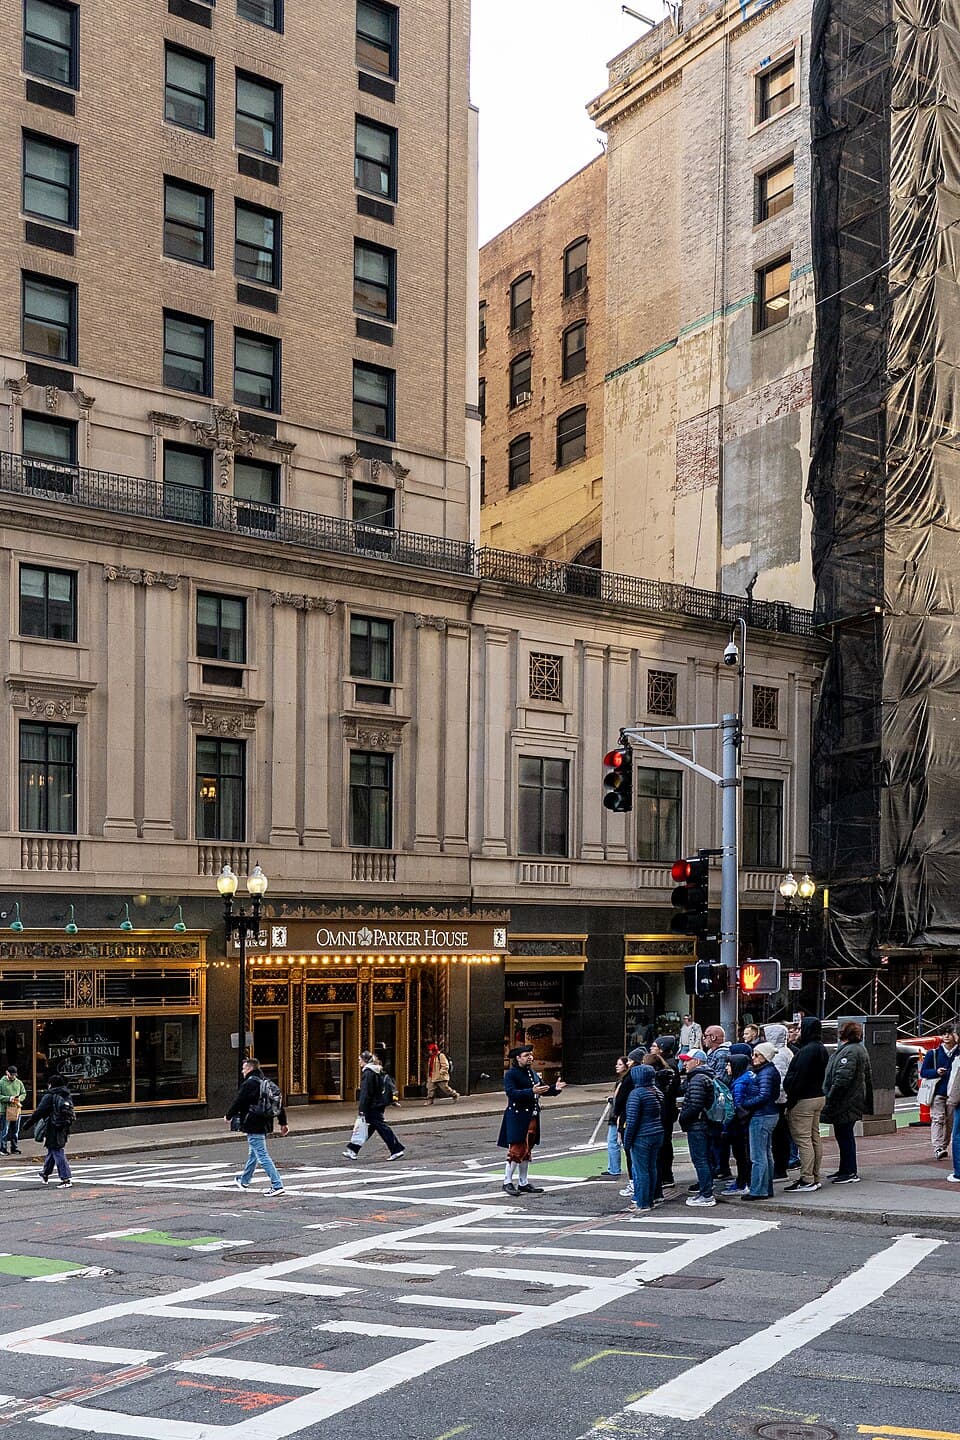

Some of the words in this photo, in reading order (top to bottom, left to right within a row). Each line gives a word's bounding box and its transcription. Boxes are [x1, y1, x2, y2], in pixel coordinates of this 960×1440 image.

[316, 928, 357, 947] OMNI
[373, 928, 421, 947] PARKER
[424, 929, 469, 947] HOUSE
[98, 945, 170, 956] HURRAH
[48, 1047, 74, 1059] LAST
[78, 1046, 120, 1056] HURRAH
